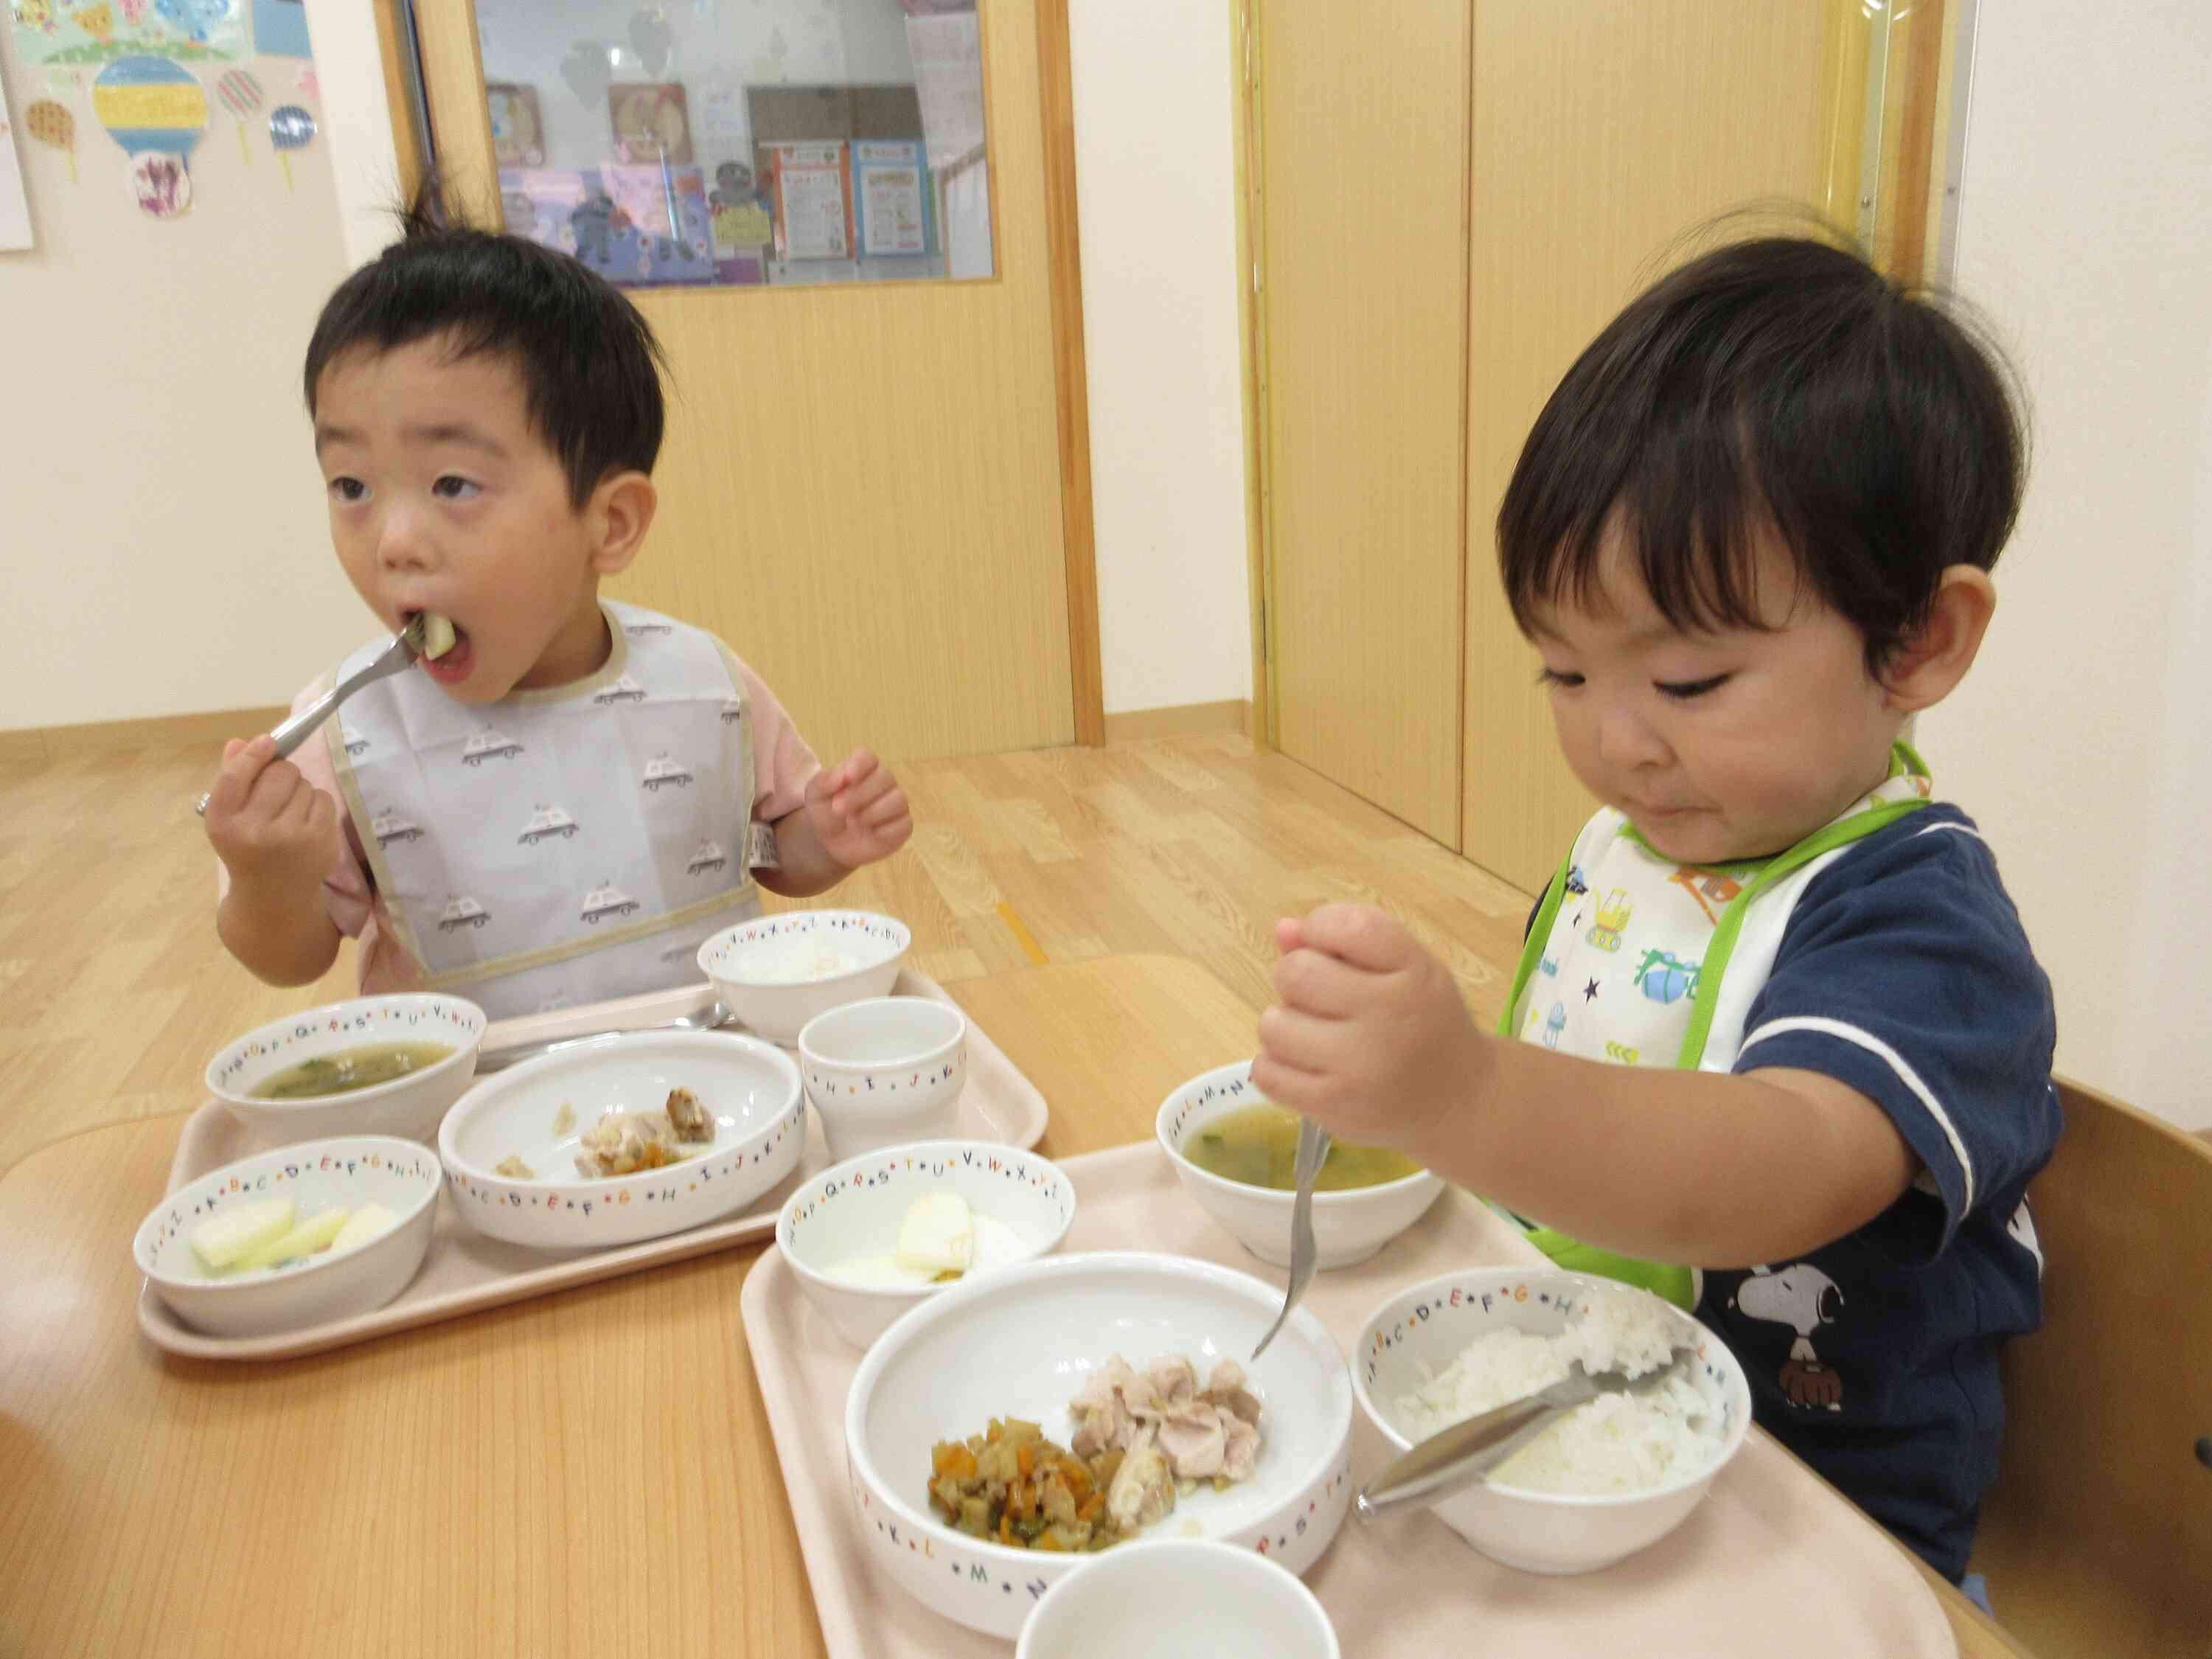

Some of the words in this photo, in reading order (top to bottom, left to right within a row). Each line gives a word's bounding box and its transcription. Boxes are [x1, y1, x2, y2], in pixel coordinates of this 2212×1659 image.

[433, 1002, 442, 1018] V
[824, 1181, 840, 1198] Q
[932, 1161, 945, 1178] U
[962, 1150, 973, 1166] V
[1017, 1163, 1028, 1181] X
[1415, 1302, 1430, 1321] D
[1449, 1286, 1462, 1308] E
[1481, 1293, 1494, 1315] F
[1553, 1293, 1573, 1317] H
[969, 1562, 989, 1584] M
